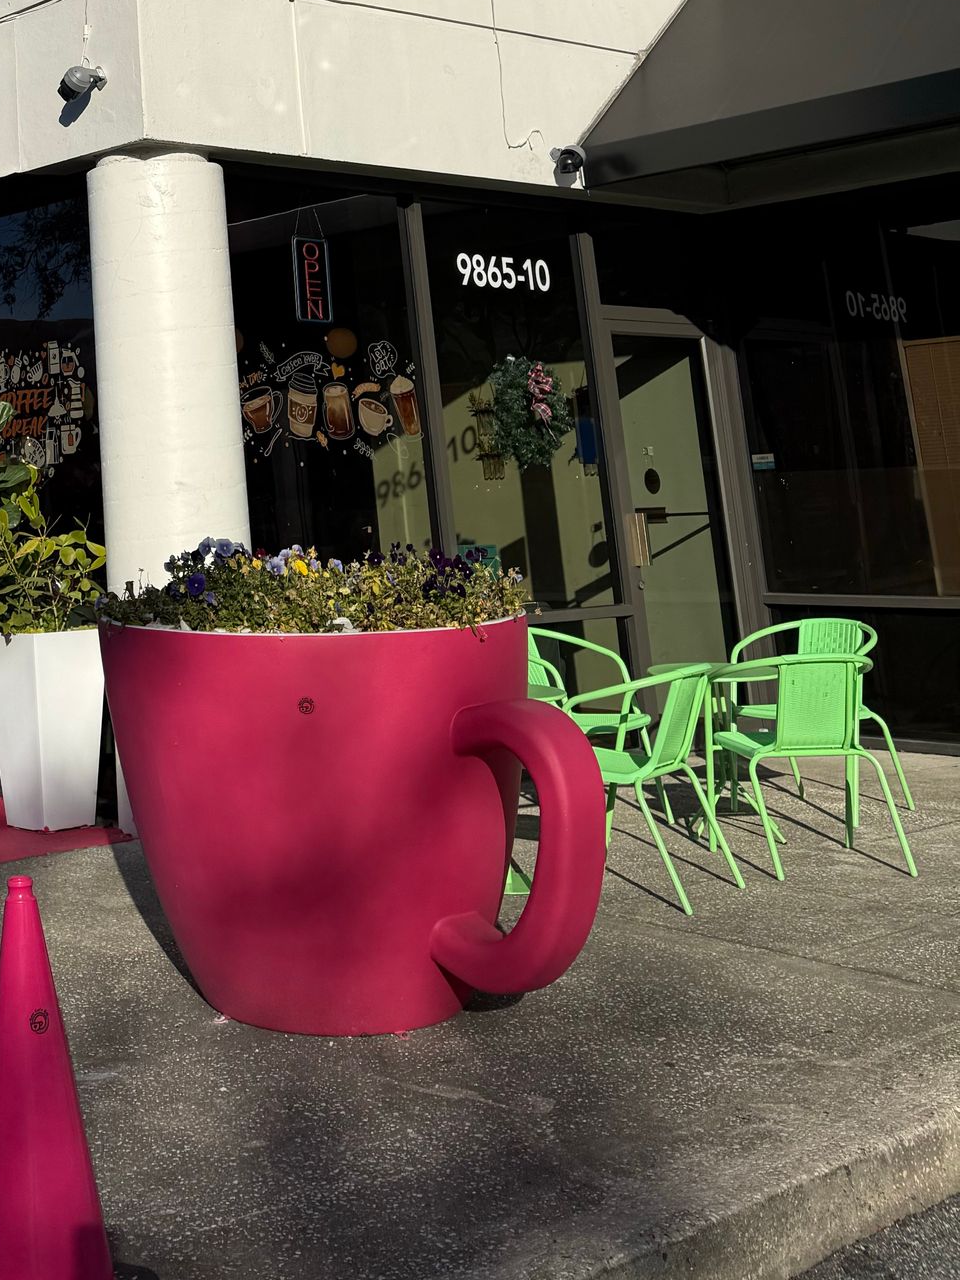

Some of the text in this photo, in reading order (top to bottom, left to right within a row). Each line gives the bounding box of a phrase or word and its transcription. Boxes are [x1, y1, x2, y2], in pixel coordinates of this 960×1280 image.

[302, 242, 324, 320] OPEN
[456, 252, 551, 292] 9865-10
[2, 416, 48, 439] BREAK
